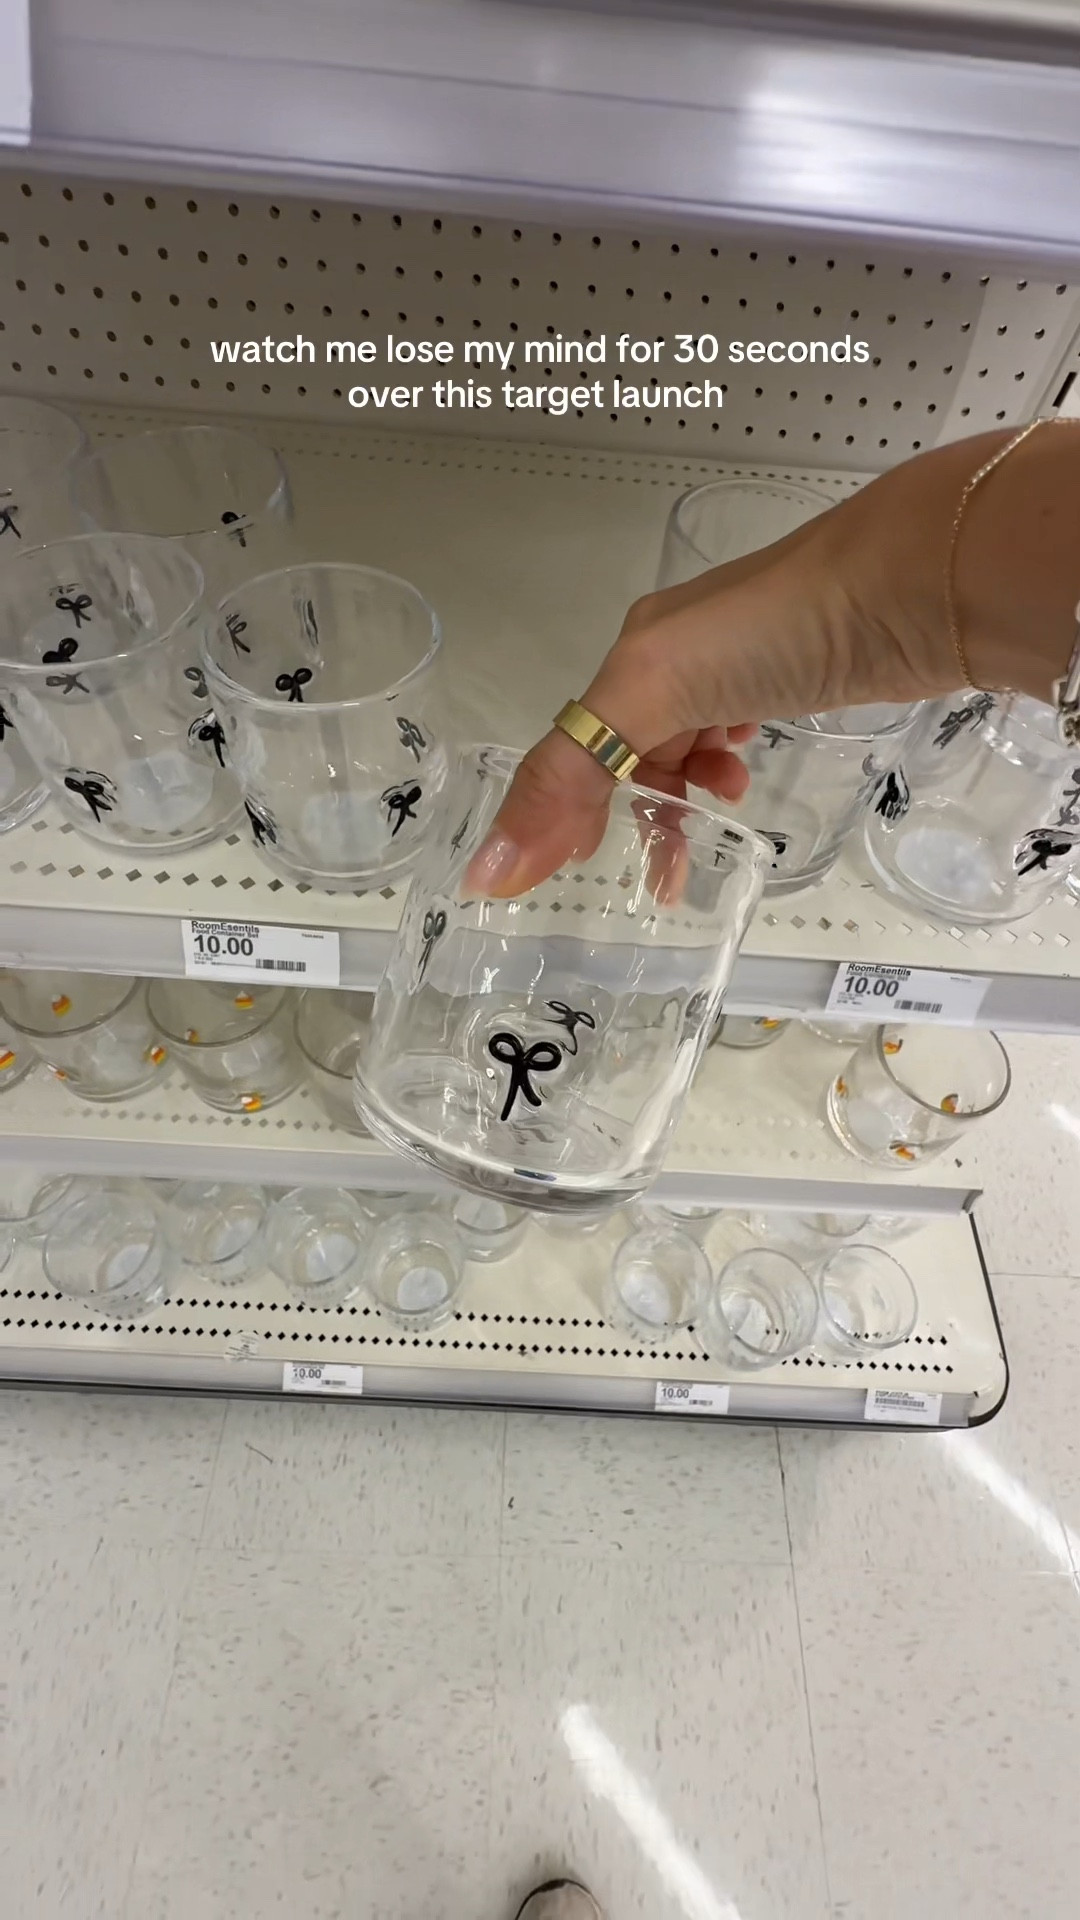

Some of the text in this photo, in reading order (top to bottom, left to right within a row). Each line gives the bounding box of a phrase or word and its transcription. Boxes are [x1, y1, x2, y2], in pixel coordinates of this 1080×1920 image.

[194, 934, 254, 956] 10.00
[844, 976, 900, 997] 10.00
[292, 1368, 322, 1379] 10.00
[661, 1387, 690, 1399] 10.00
